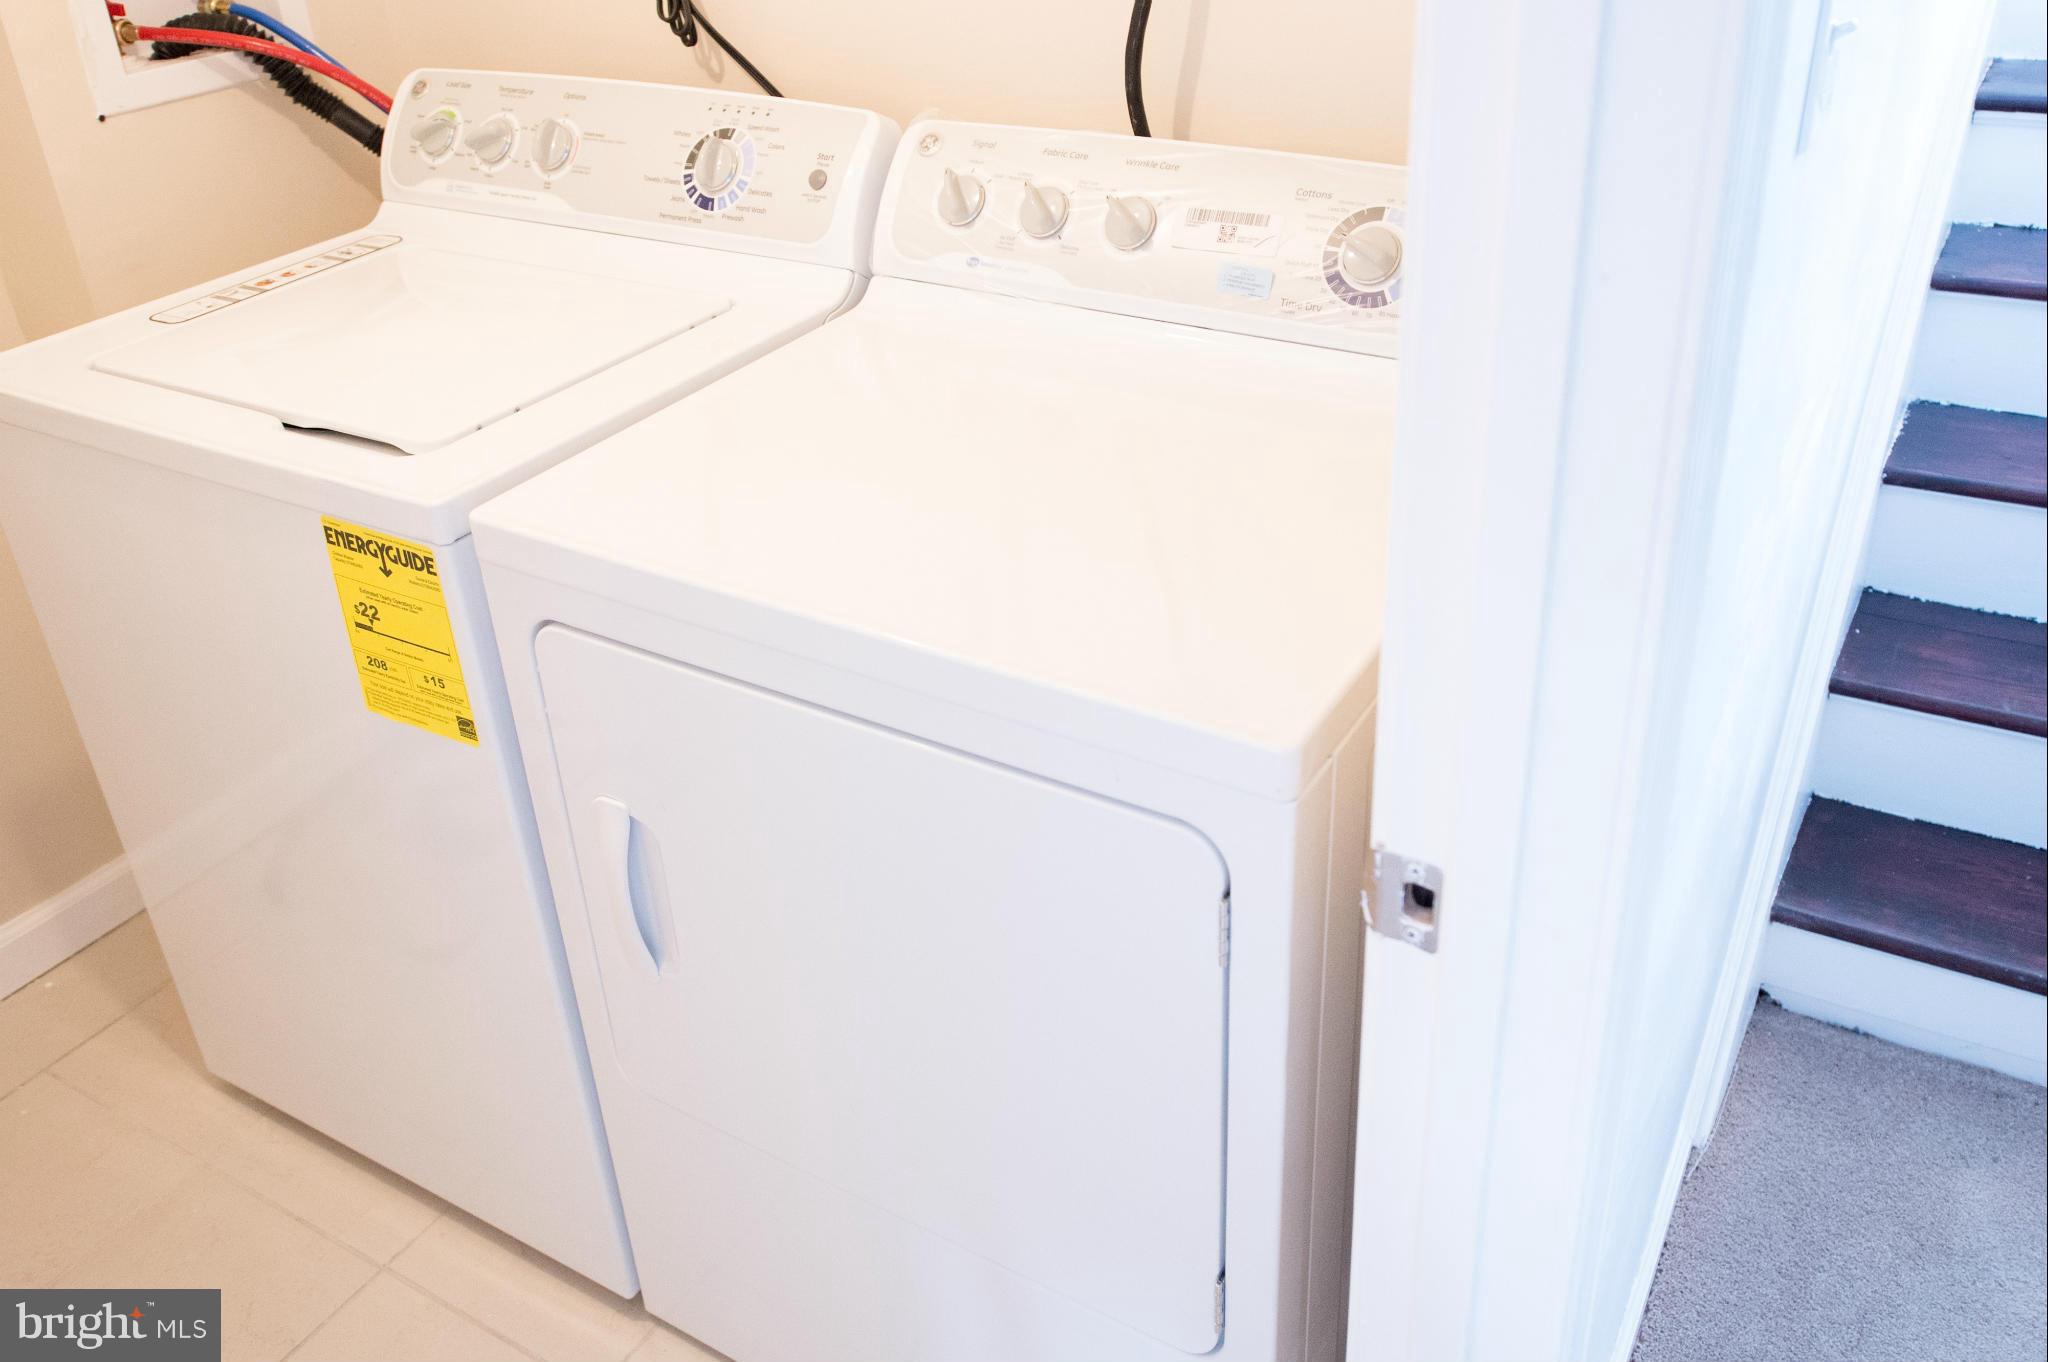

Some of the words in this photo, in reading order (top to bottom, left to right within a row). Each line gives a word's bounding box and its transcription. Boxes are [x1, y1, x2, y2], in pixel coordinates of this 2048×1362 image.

[498, 85, 535, 95] Temperature
[562, 92, 587, 101] Options
[767, 142, 785, 151] Colors
[972, 139, 998, 150] Signal
[816, 152, 835, 161] Start
[1041, 147, 1068, 159] Fabric
[1069, 151, 1089, 161] Care
[1125, 157, 1158, 169] Wrinkle
[1159, 160, 1181, 171] Care
[1295, 187, 1335, 200] Cottons
[735, 204, 751, 213] Hand
[751, 207, 768, 215] Wash
[323, 525, 438, 577] ENERGYGUIDE
[366, 655, 388, 671] 208
